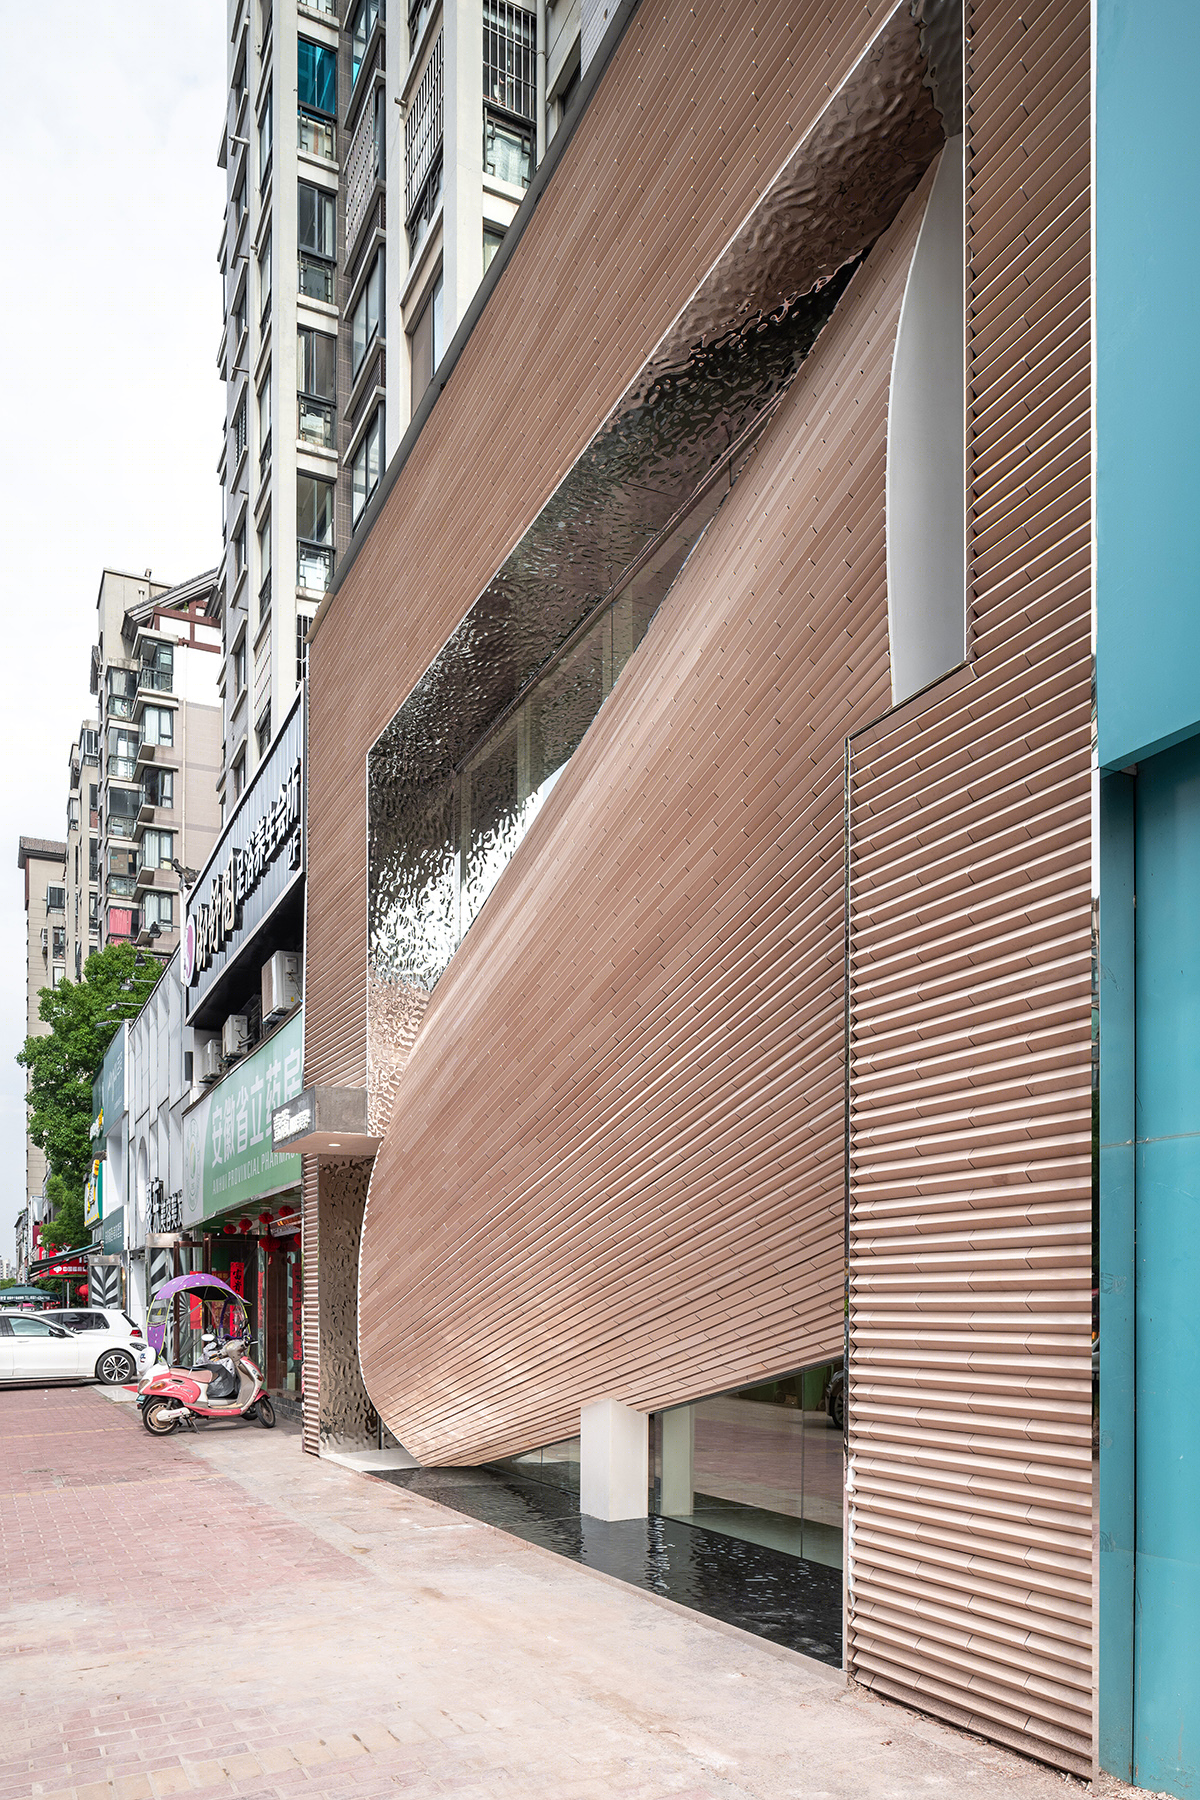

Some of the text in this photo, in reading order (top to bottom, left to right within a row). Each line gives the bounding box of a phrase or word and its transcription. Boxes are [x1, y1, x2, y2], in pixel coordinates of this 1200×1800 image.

[236, 759, 300, 905] 足浴养生会所
[288, 828, 301, 864] 2F
[212, 1048, 302, 1168] 安徽省立药房
[213, 1152, 301, 1195] ANHUI PROVINCIAL PHARMA
